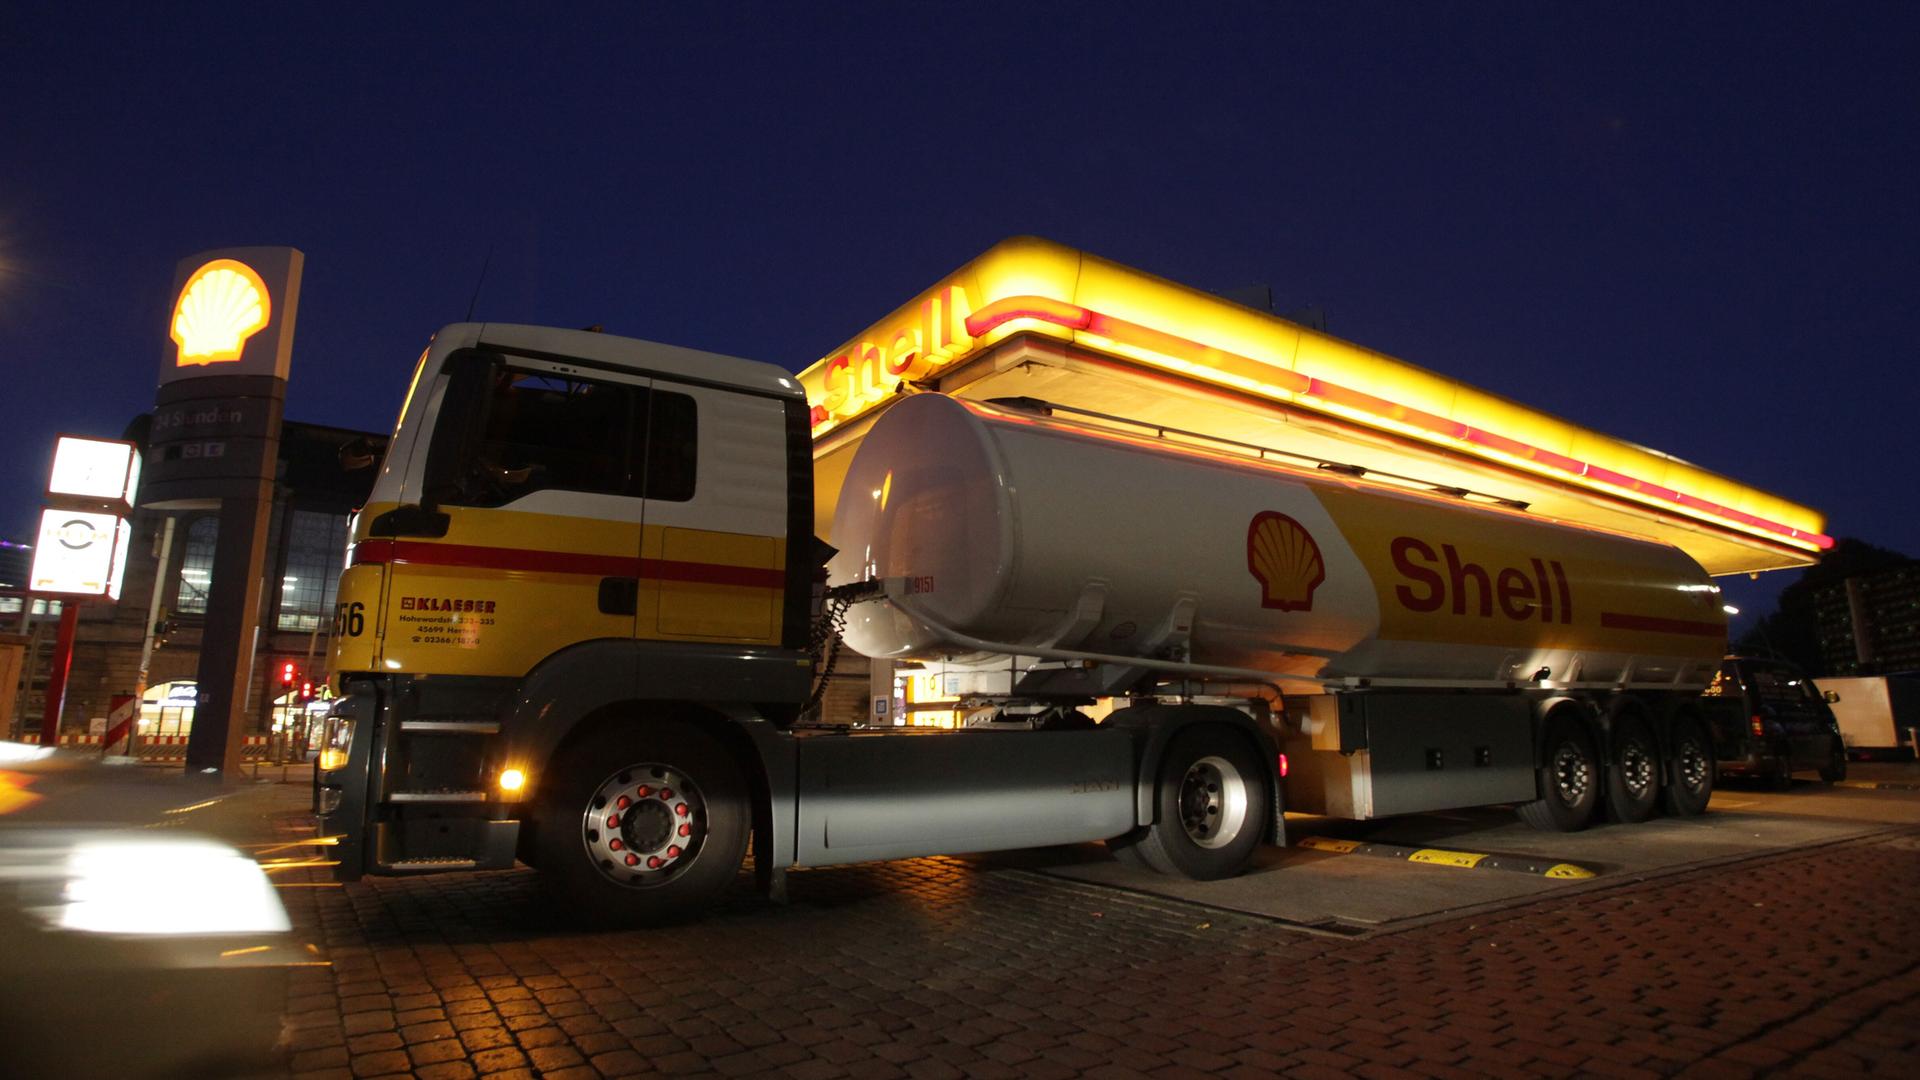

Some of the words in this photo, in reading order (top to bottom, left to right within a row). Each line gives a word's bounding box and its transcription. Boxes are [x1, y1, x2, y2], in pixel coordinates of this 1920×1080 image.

[824, 285, 973, 415] Shell
[172, 407, 242, 426] Stundn
[914, 576, 934, 593] 9151
[1390, 536, 1572, 624] Shell
[416, 597, 496, 614] KLAESER
[399, 615, 456, 624] Hohewardstr
